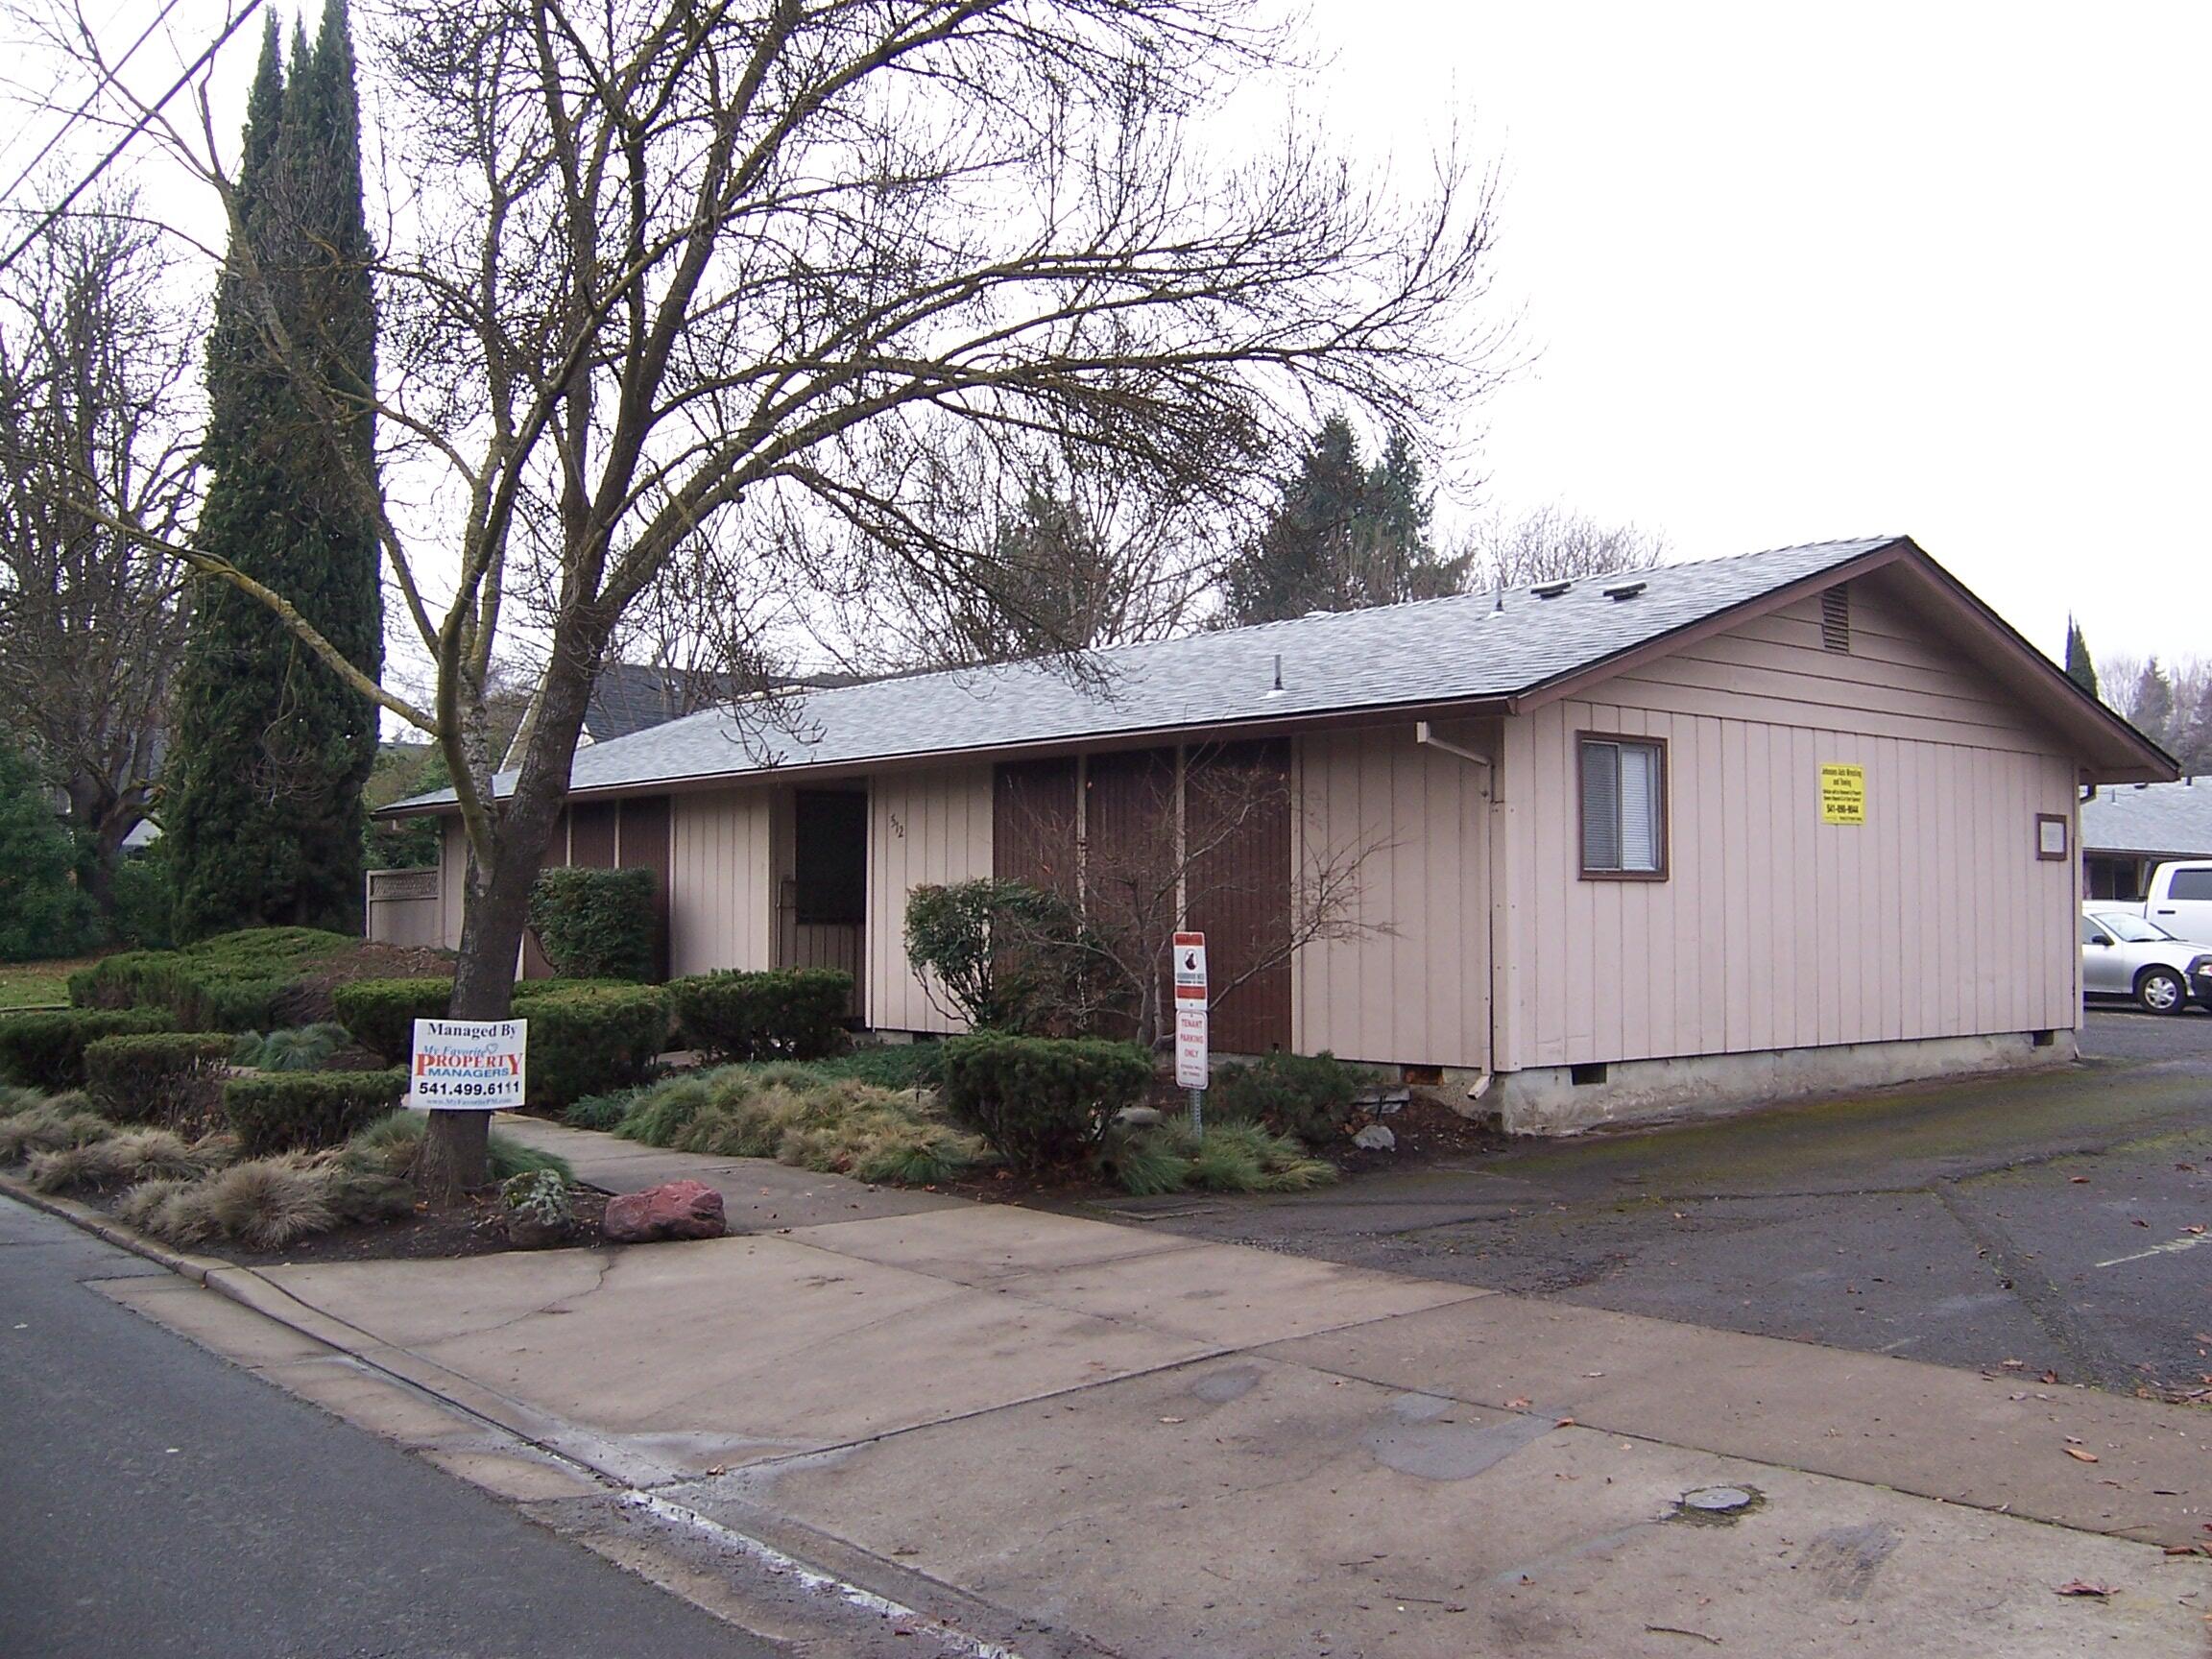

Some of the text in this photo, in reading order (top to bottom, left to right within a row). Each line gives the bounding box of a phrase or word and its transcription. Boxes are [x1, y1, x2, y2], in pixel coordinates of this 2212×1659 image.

[1181, 1019, 1203, 1029] TENANT
[428, 1022, 517, 1041] Managed By
[1180, 1034, 1204, 1045] PARKING
[423, 1045, 487, 1057] My Favorite
[1184, 1048, 1199, 1058] ONLY
[416, 1052, 523, 1076] PROPERTY
[428, 1068, 510, 1078] MANAGERS
[419, 1081, 519, 1095] 541.499.6111
